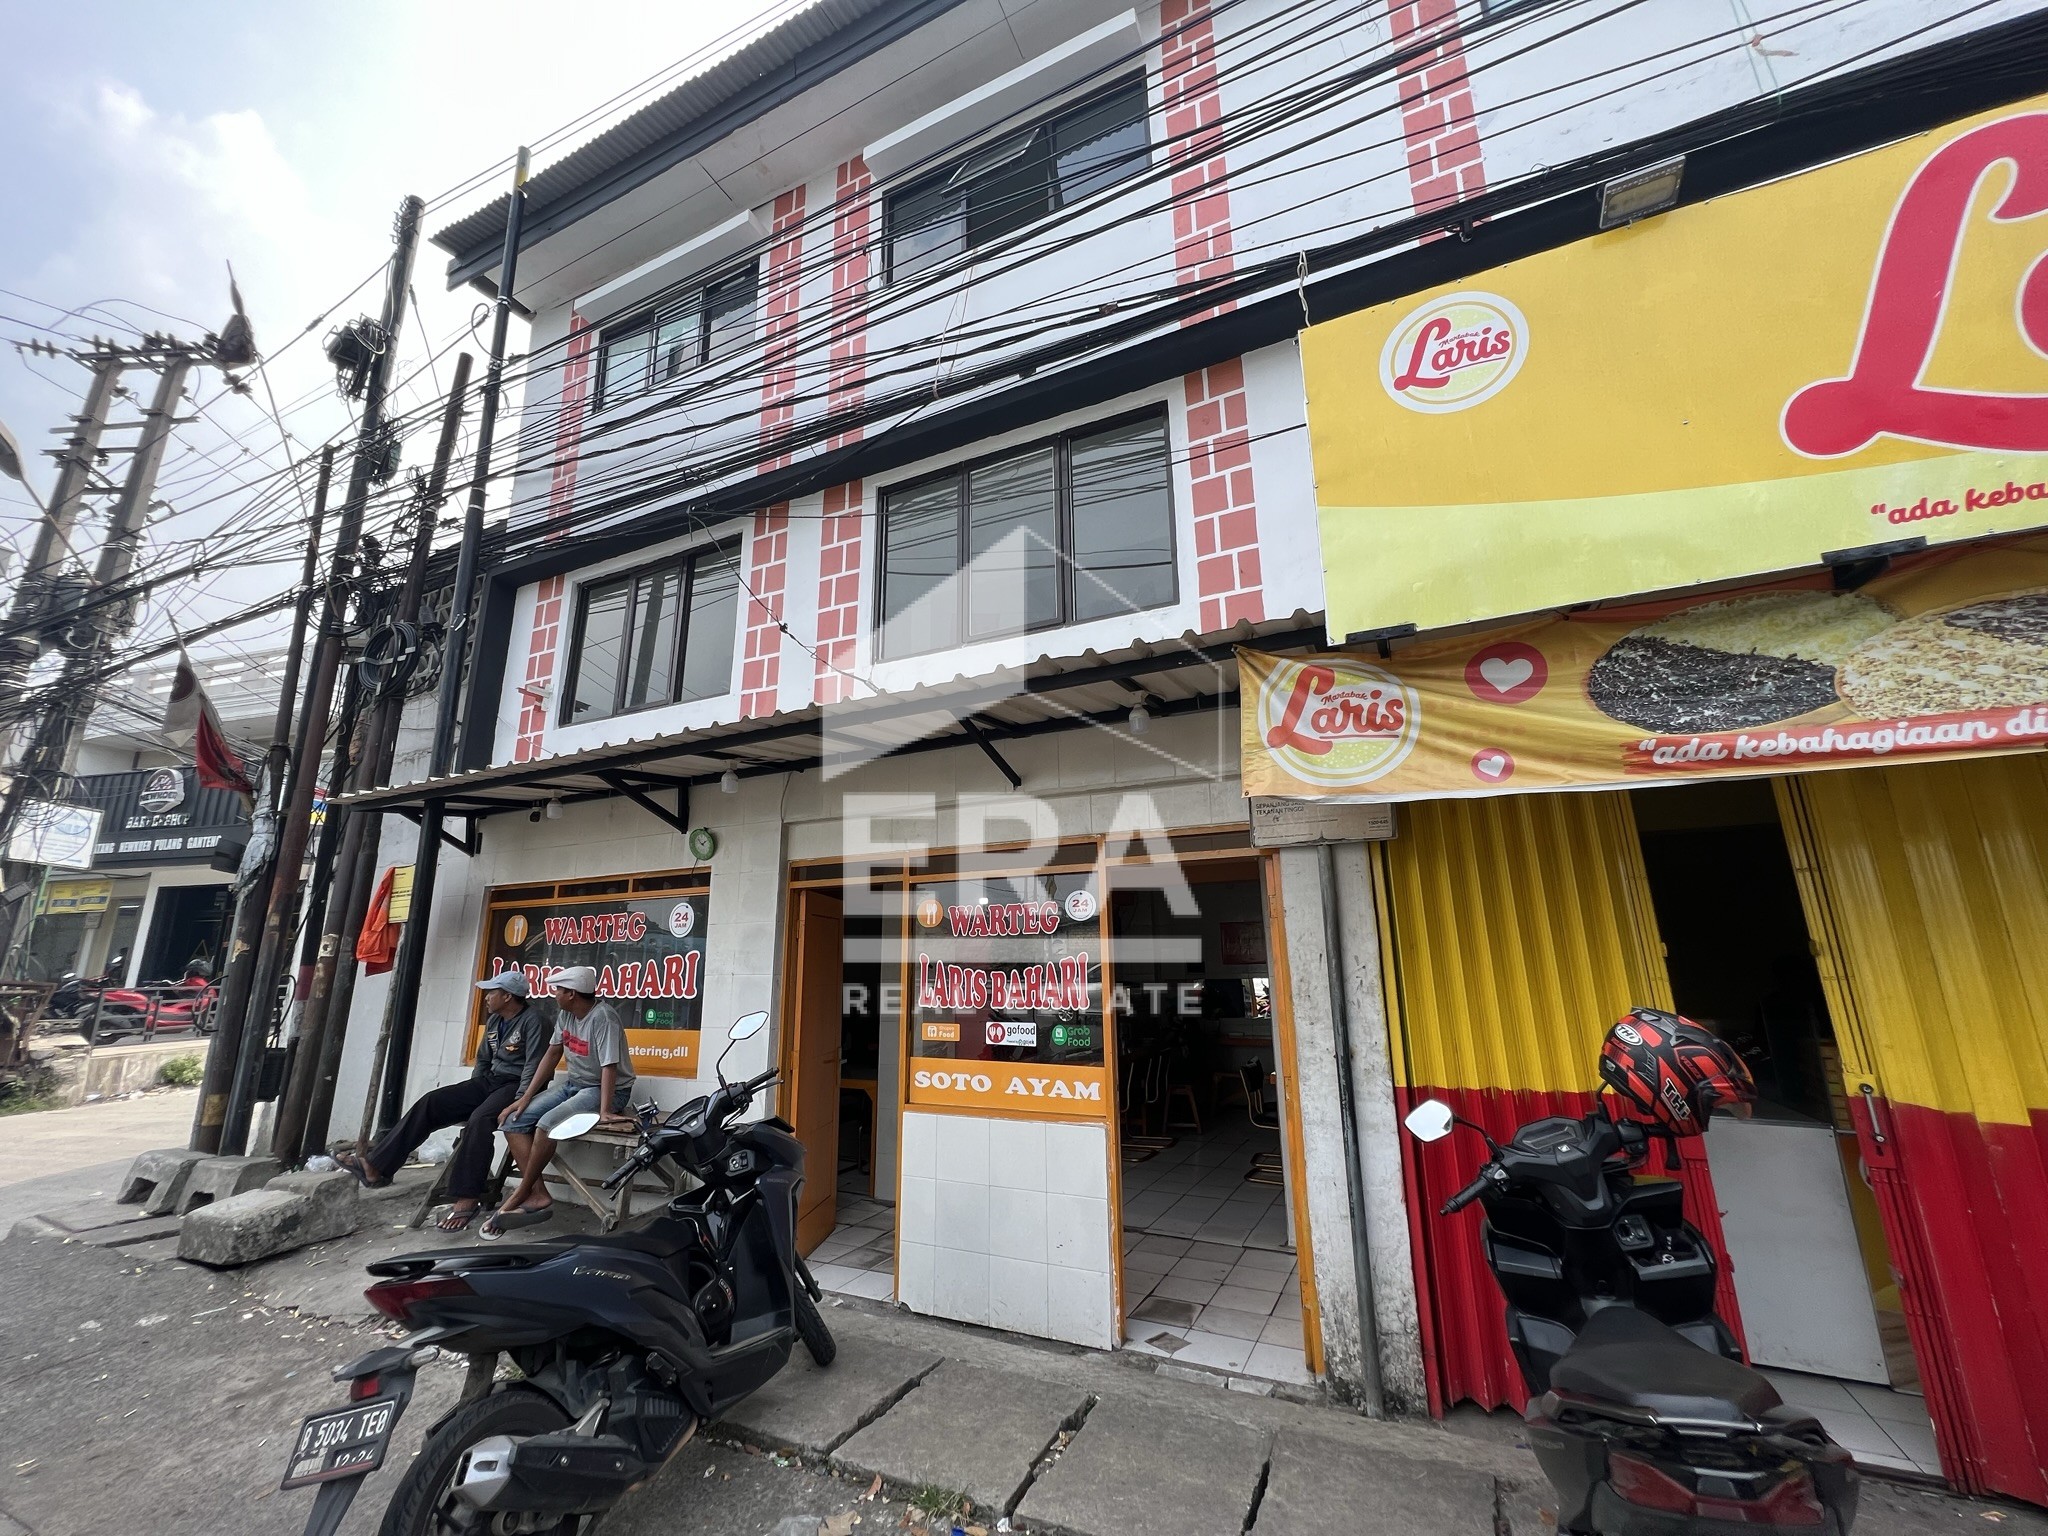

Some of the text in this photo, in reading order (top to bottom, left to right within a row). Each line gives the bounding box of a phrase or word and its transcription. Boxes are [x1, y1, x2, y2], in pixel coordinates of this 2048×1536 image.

[1393, 317, 1511, 391] Laris
[1266, 664, 1404, 756] Laris
[1320, 691, 1368, 705] Martabak
[1733, 717, 1998, 755] kebahagiaan
[153, 838, 183, 851] PULANG
[674, 912, 689, 922] 24
[1072, 899, 1089, 908] 24
[544, 912, 647, 945] WARTEG
[948, 901, 1059, 937] WARTEG
[594, 950, 701, 999] AHARI
[918, 952, 1090, 1010] LARIS BAHARI
[1006, 1025, 1036, 1036] gofood
[1067, 1026, 1091, 1036] Grab
[1067, 1037, 1091, 1047] Food
[628, 1046, 689, 1059] atering,dll
[914, 1071, 1101, 1100] SOTO AYAM
[301, 1426, 313, 1452] B
[314, 1417, 354, 1448] 5034
